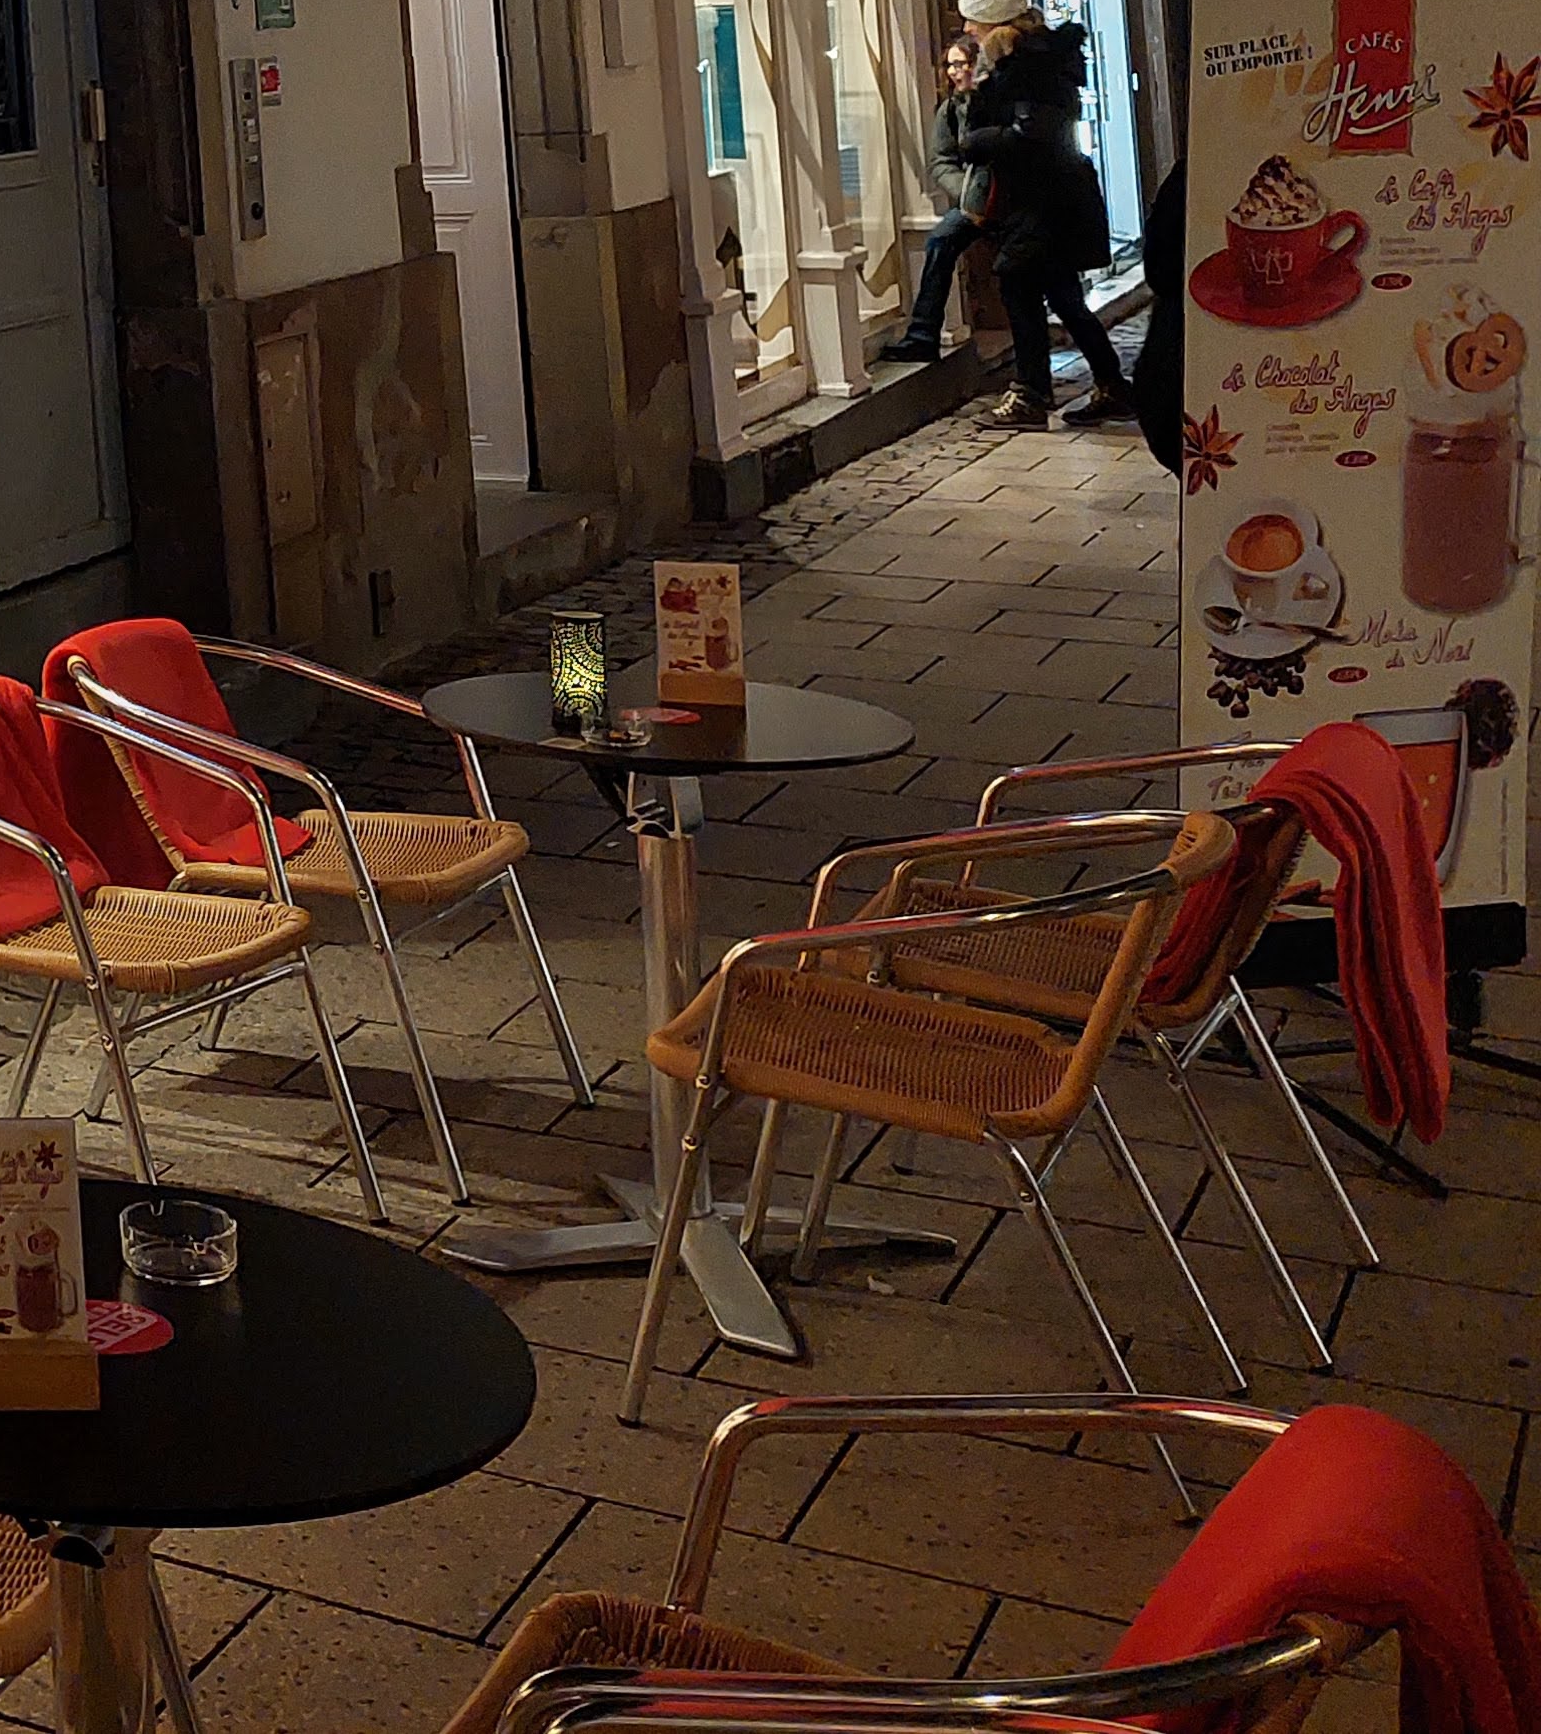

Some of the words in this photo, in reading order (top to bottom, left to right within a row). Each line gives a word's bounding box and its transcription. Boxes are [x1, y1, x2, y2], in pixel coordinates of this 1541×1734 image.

[1203, 43, 1236, 62] SUR
[1239, 33, 1290, 54] PLACE
[1345, 30, 1405, 54] CAFÉS
[1205, 62, 1228, 78] OU
[1302, 60, 1441, 143] Henri
[1255, 349, 1341, 389] Chocolat
[1289, 388, 1317, 415] des
[1324, 374, 1397, 439] Anges
